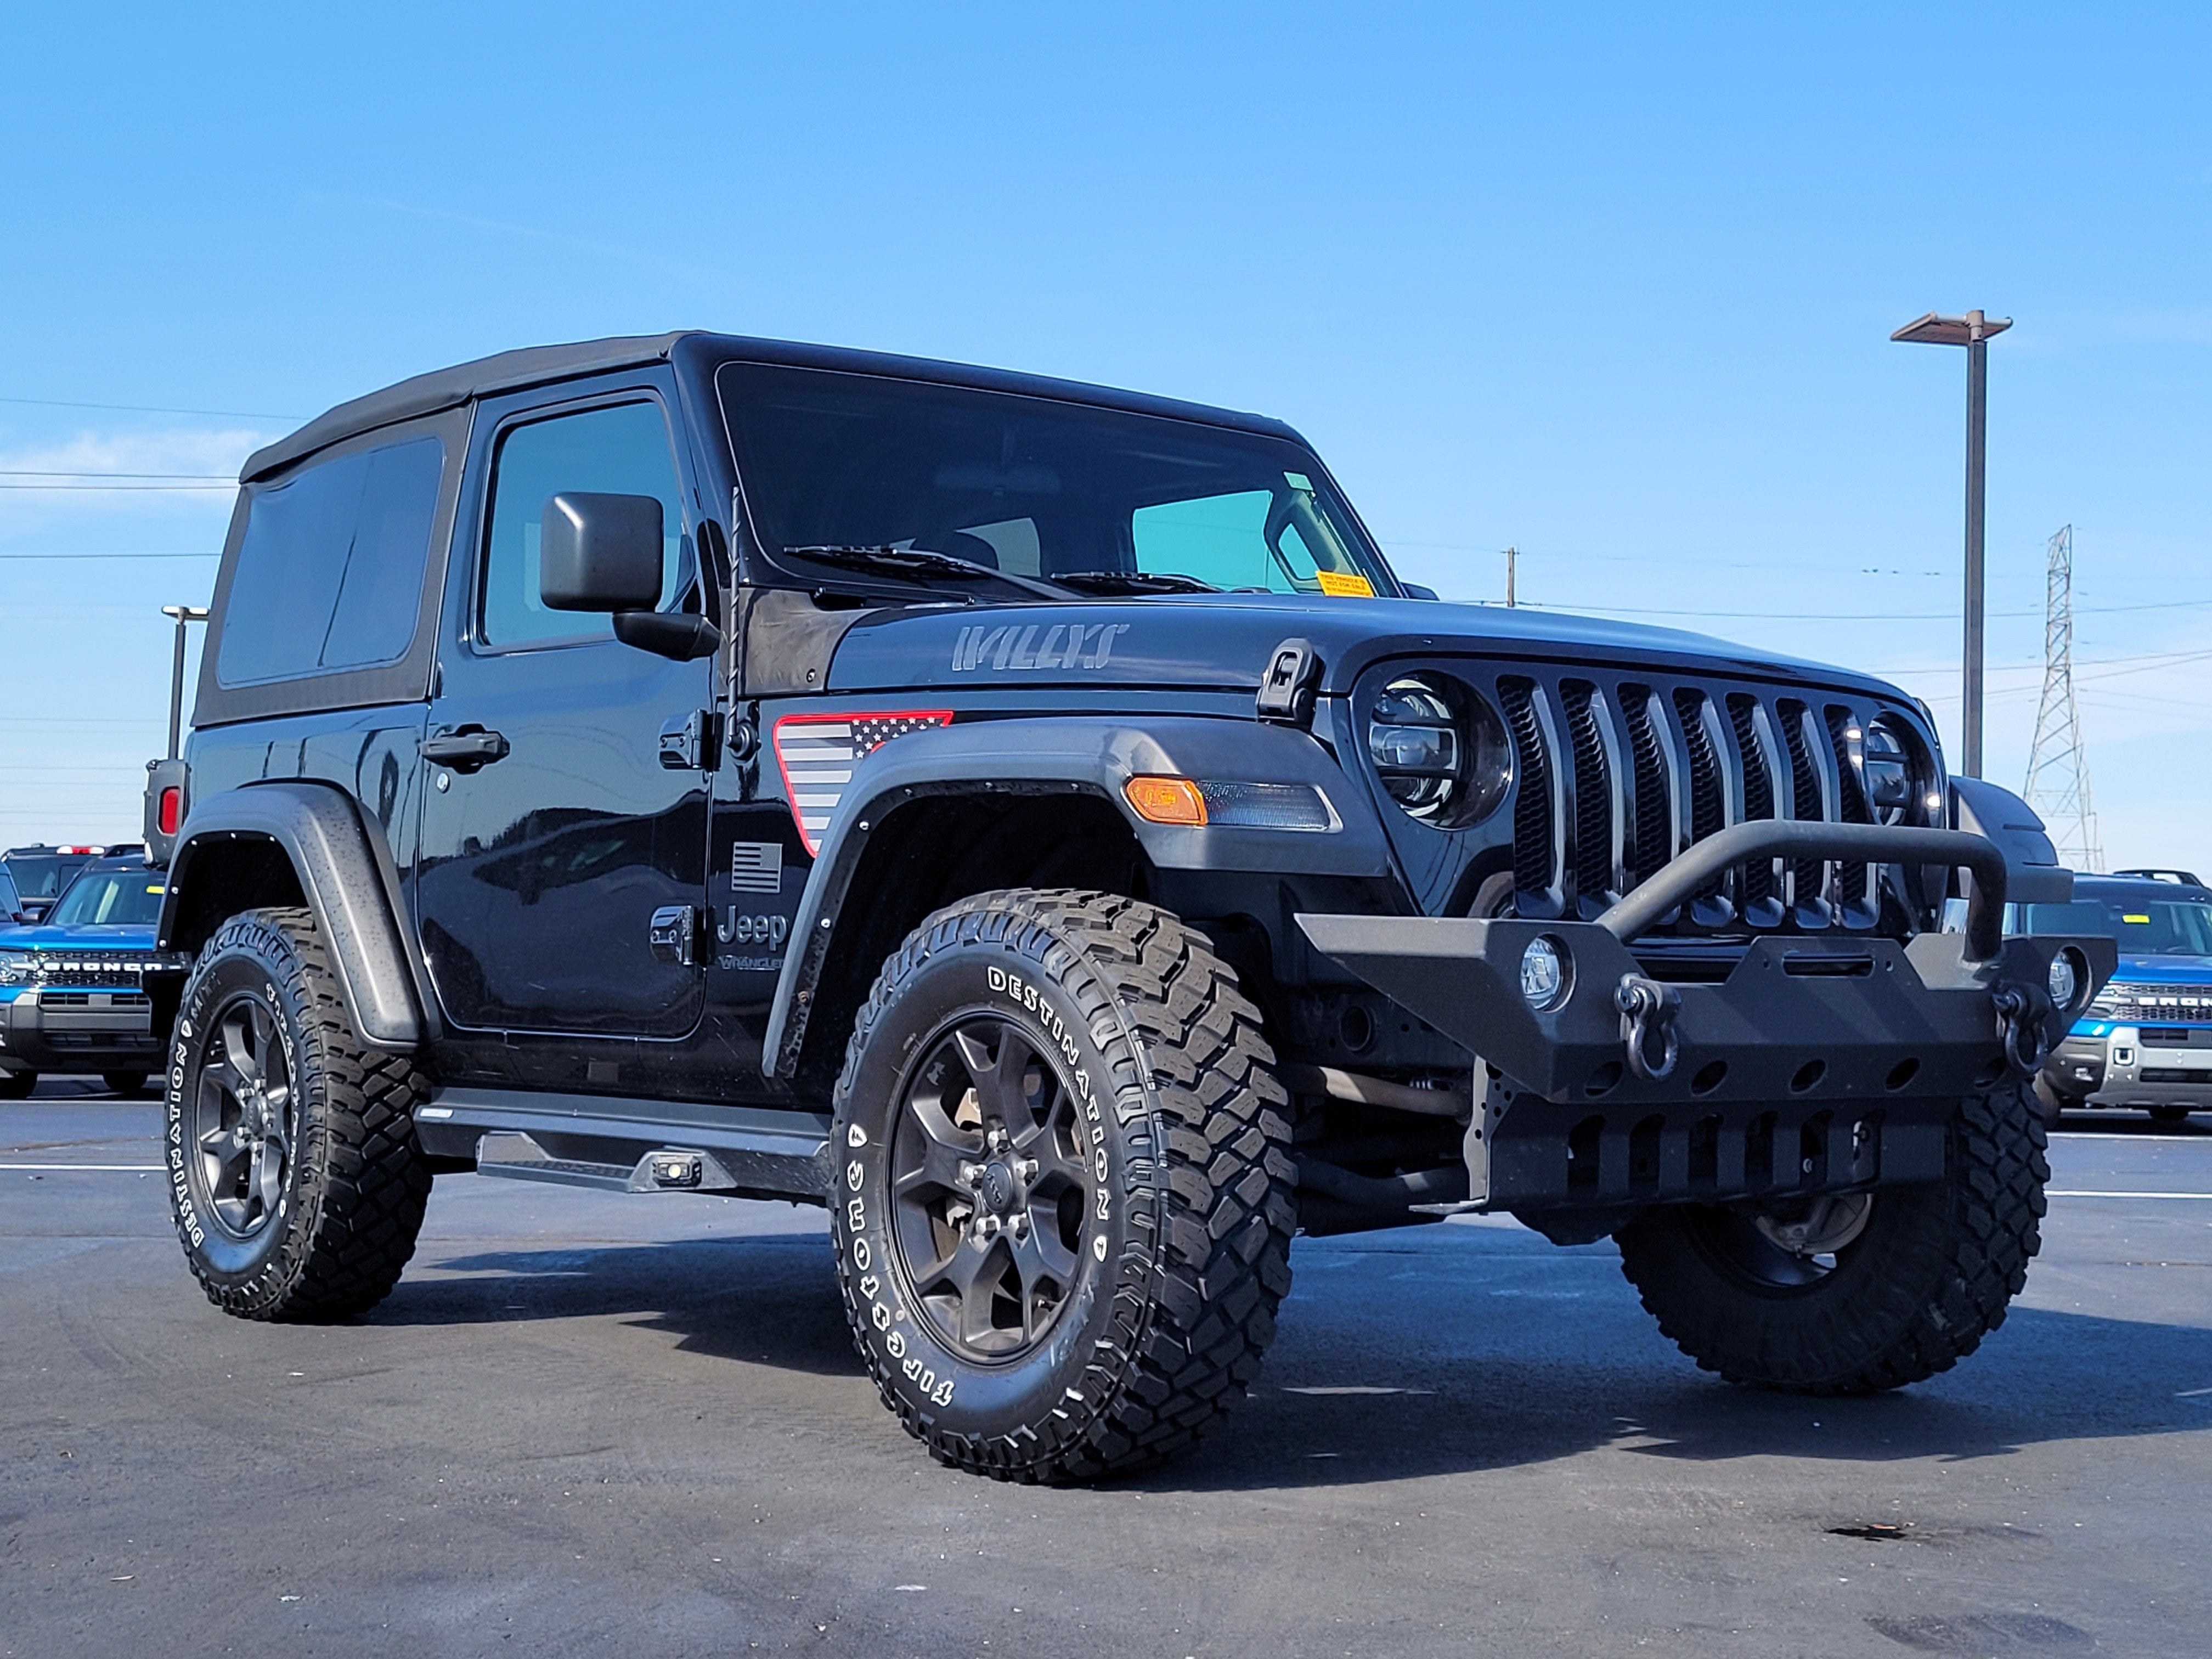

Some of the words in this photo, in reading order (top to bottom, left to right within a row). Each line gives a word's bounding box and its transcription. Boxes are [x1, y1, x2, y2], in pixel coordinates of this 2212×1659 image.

[952, 624, 1130, 671] WILLYS
[717, 905, 787, 951] Jeep
[169, 1042, 205, 1249] DESTINATION
[987, 966, 1109, 1221] DESTINATION
[848, 1159, 953, 1407] Firestone
